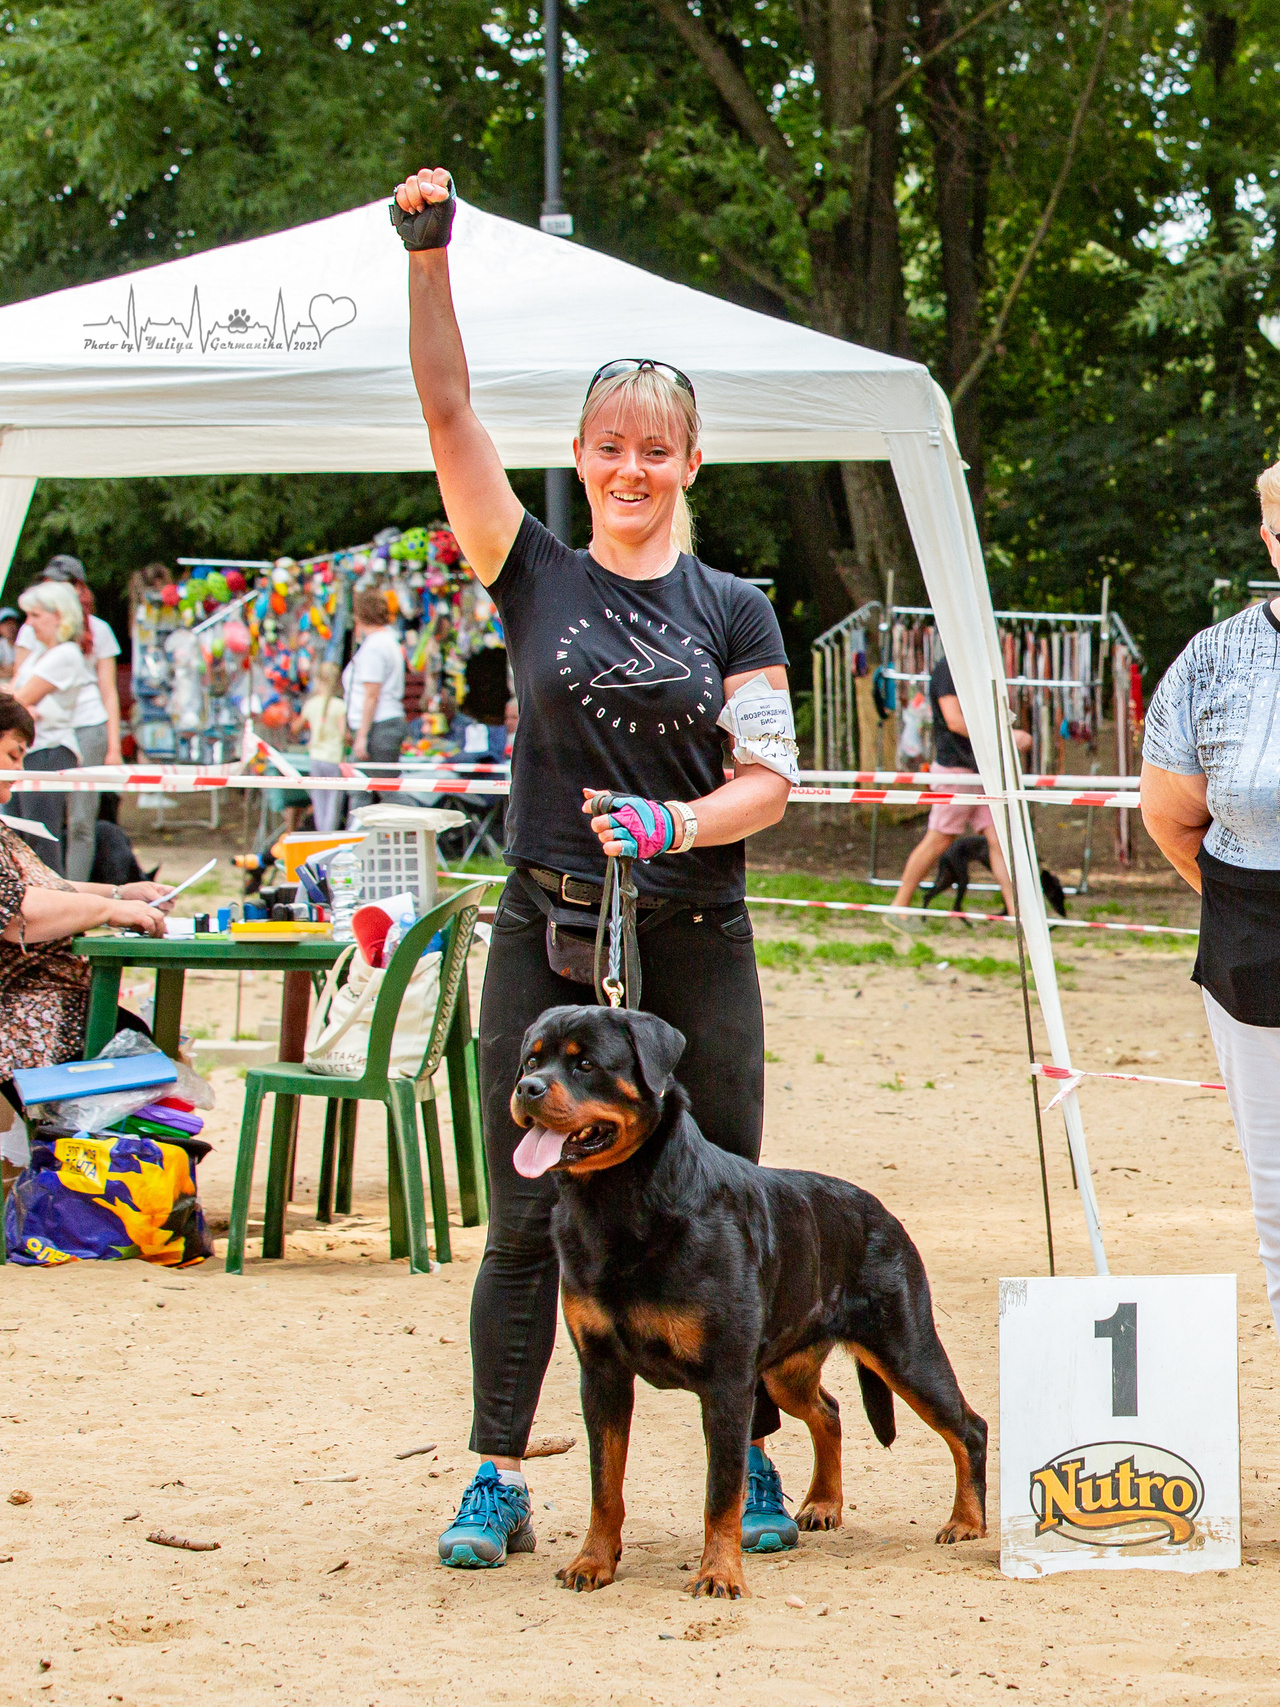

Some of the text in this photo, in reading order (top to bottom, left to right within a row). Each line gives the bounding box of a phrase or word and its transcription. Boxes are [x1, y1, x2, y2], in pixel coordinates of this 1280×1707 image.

[556, 618, 637, 733] SPORTSWEAR
[657, 636, 714, 735] AUTHENTIC
[1094, 1302, 1138, 1417] 1
[1031, 1454, 1197, 1538] Nutro
